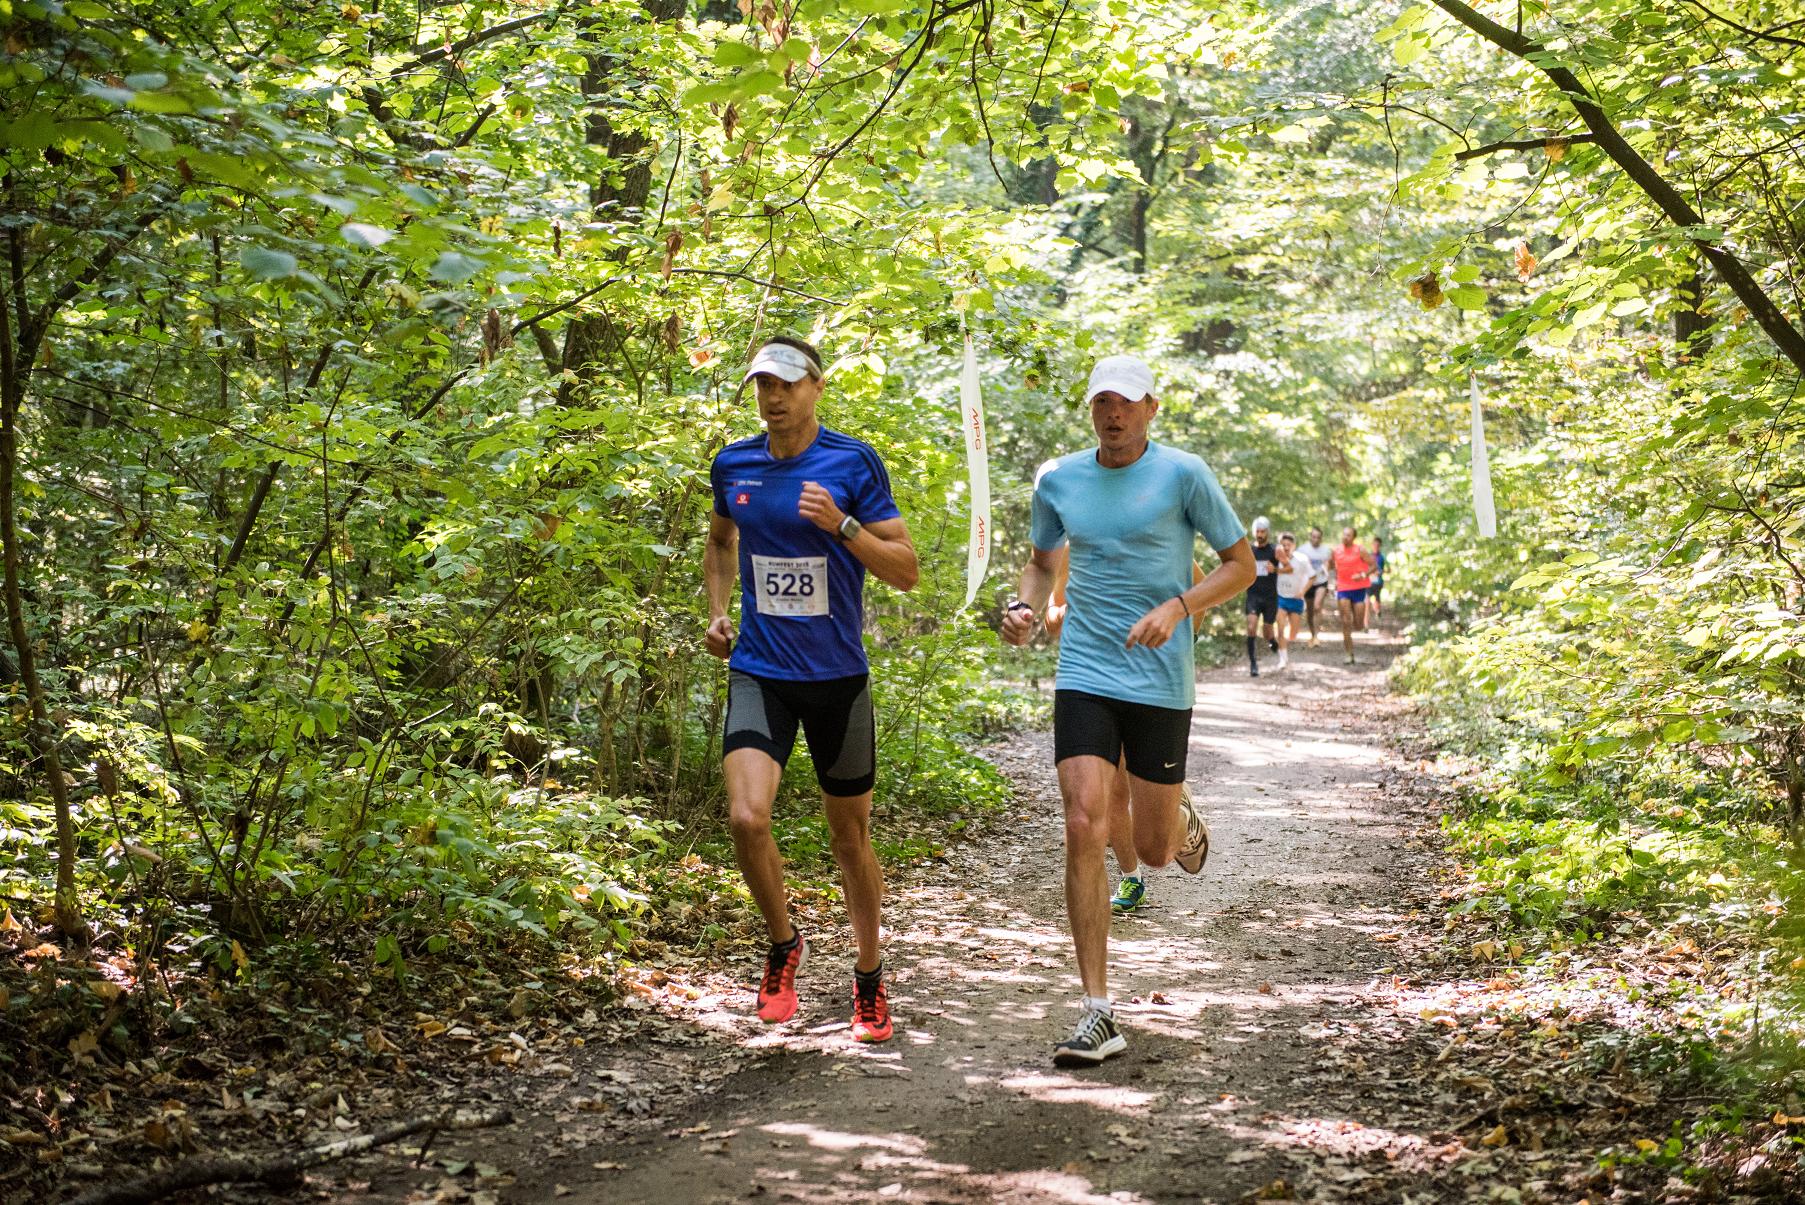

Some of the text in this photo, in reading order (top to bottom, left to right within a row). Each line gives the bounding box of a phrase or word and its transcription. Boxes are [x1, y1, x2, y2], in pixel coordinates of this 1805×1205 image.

[971, 408, 982, 450] MPG
[977, 516, 985, 560] MPG
[766, 572, 815, 597] 528
